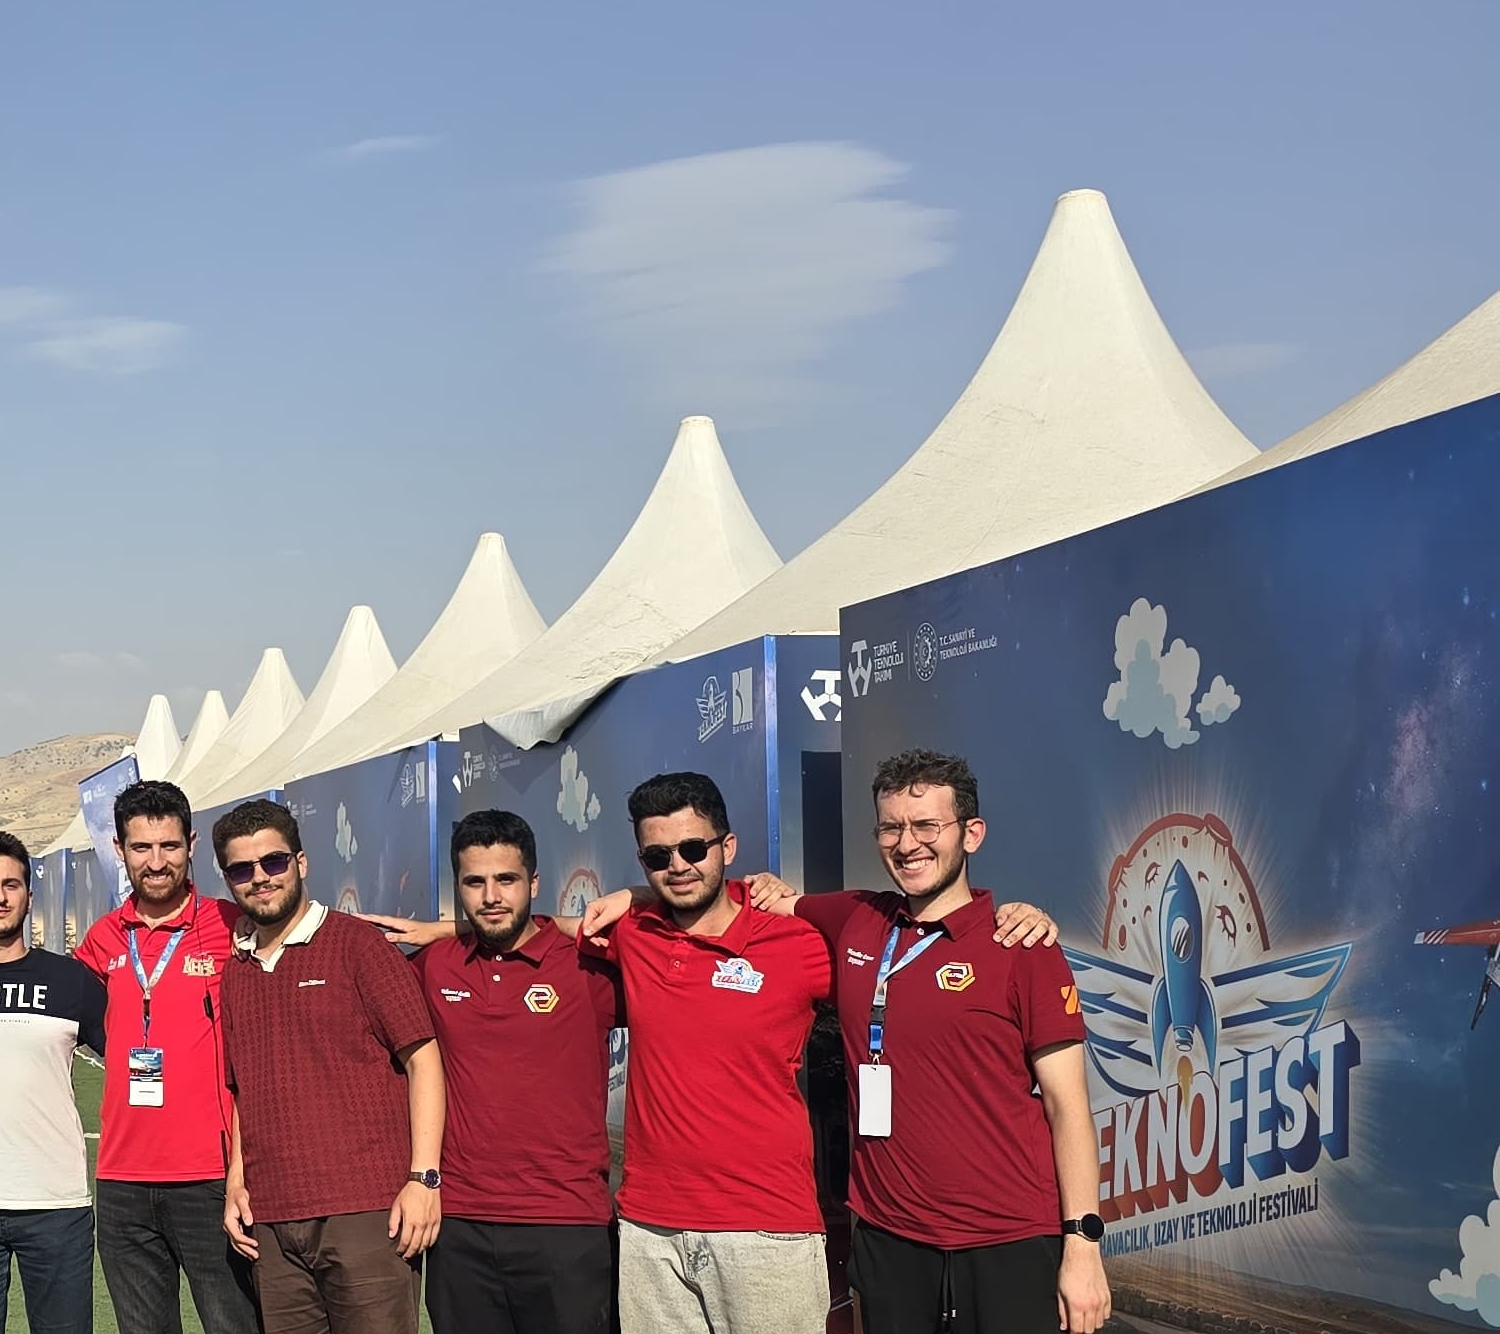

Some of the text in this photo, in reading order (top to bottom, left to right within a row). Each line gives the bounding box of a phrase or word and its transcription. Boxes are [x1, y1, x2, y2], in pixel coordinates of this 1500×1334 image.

[1093, 1019, 1347, 1200] EKNOFEST
[1154, 1218, 1180, 1247] UZAY
[1181, 1212, 1197, 1241] VE
[1197, 1192, 1258, 1236] TEKNOLOJİ
[1258, 1177, 1319, 1223] FESTİVALİ
